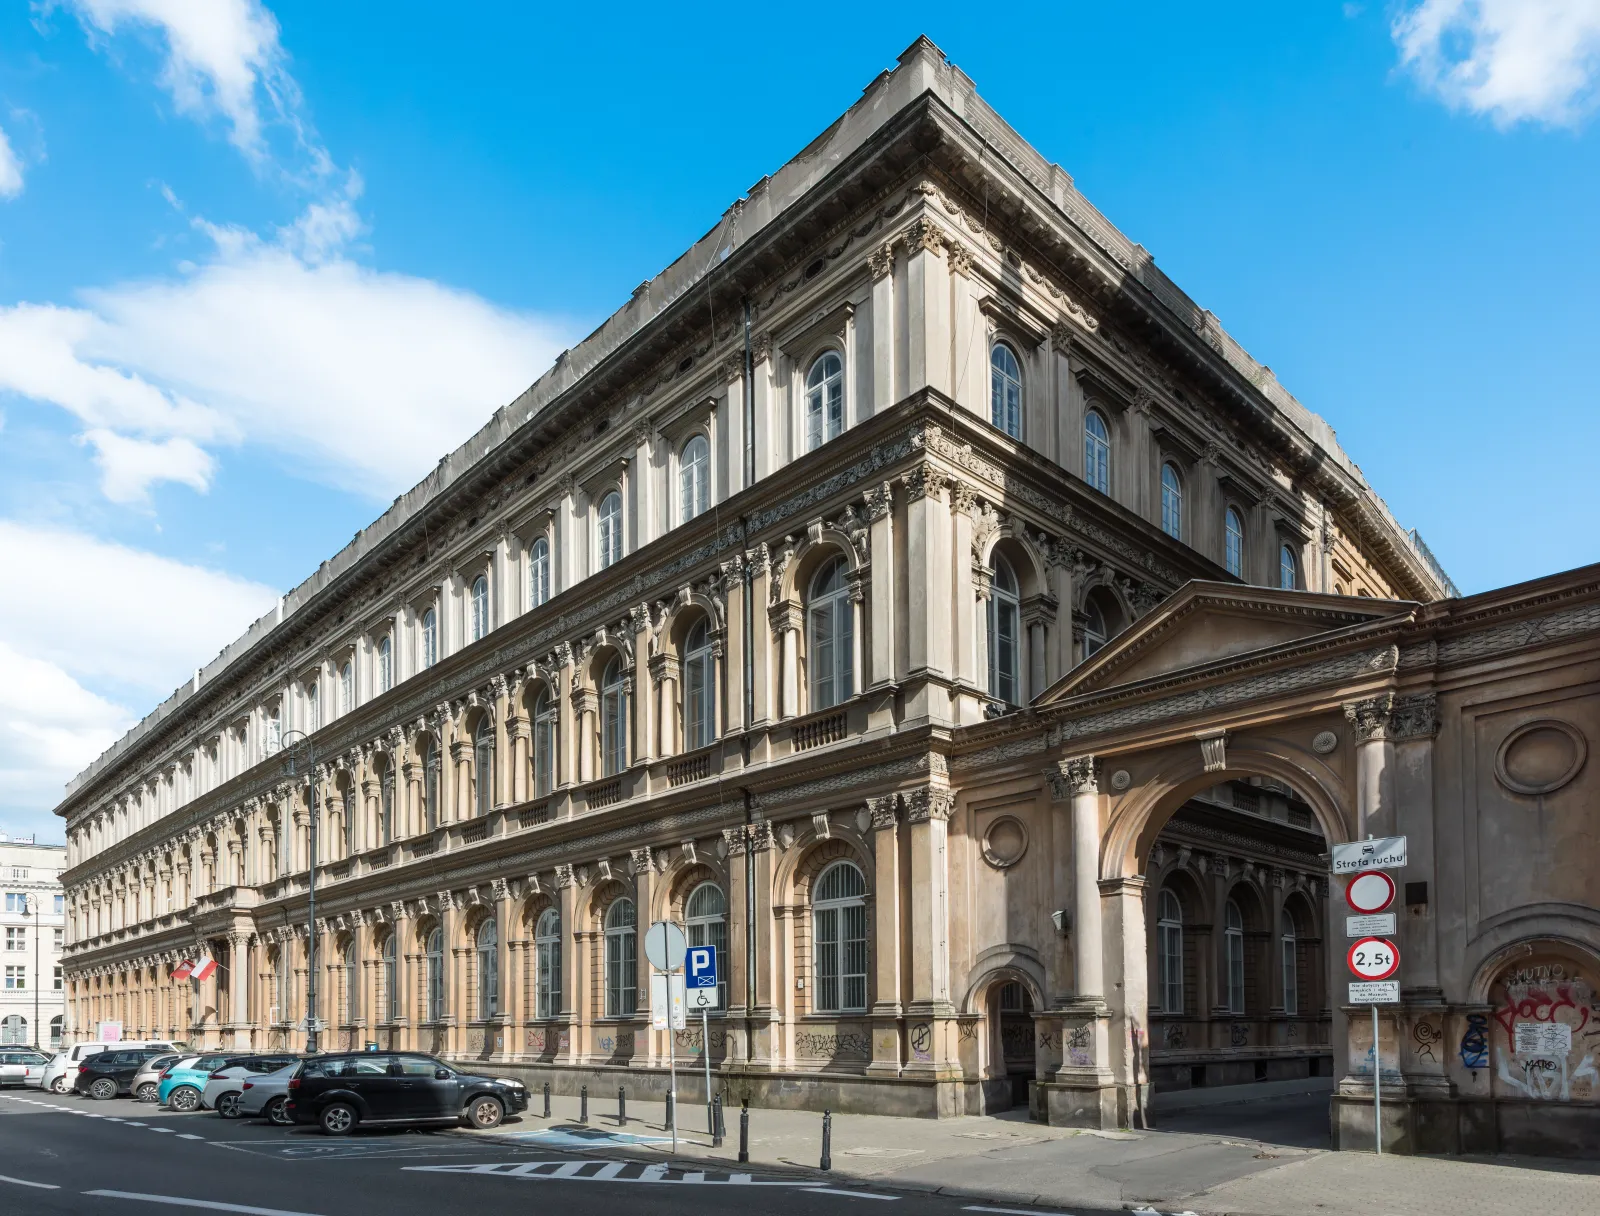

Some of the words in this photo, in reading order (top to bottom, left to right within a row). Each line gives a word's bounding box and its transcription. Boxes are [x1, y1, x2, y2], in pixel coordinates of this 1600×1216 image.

[1336, 858, 1369, 869] Strefa
[1372, 854, 1403, 865] ruchu
[691, 949, 709, 977] P
[1355, 951, 1391, 967] 2,5t
[1508, 963, 1564, 981] SMUTNO
